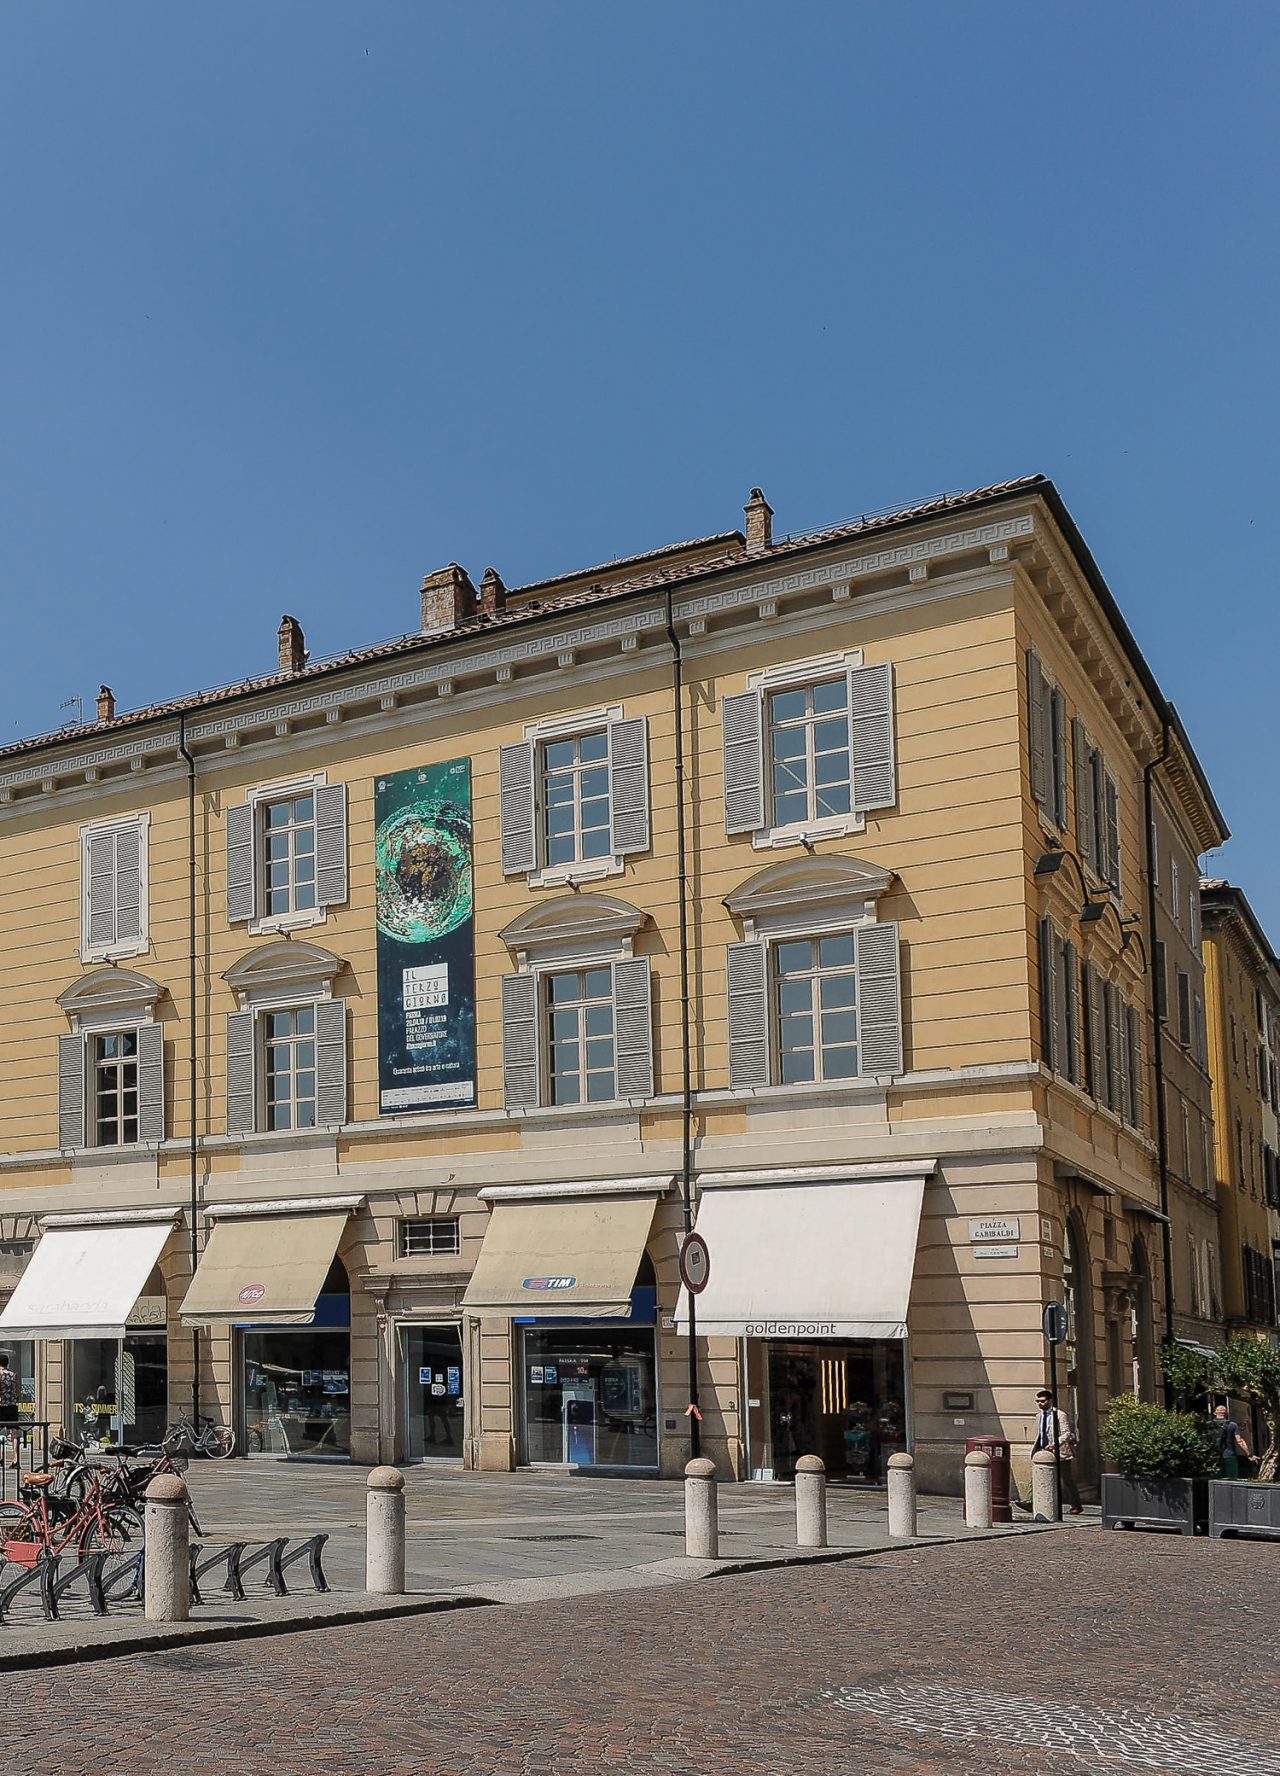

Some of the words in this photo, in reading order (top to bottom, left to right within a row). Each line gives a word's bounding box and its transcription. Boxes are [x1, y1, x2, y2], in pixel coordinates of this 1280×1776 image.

[405, 970, 416, 981] IL
[405, 981, 439, 994] TERZO
[405, 993, 446, 1008] GIORNO
[406, 1034, 415, 1042] DEL
[975, 1230, 1014, 1238] GARIBALDI
[547, 1278, 572, 1288] TIM
[745, 1321, 837, 1336] goldenpoint
[91, 1403, 118, 1414] SUMMER
